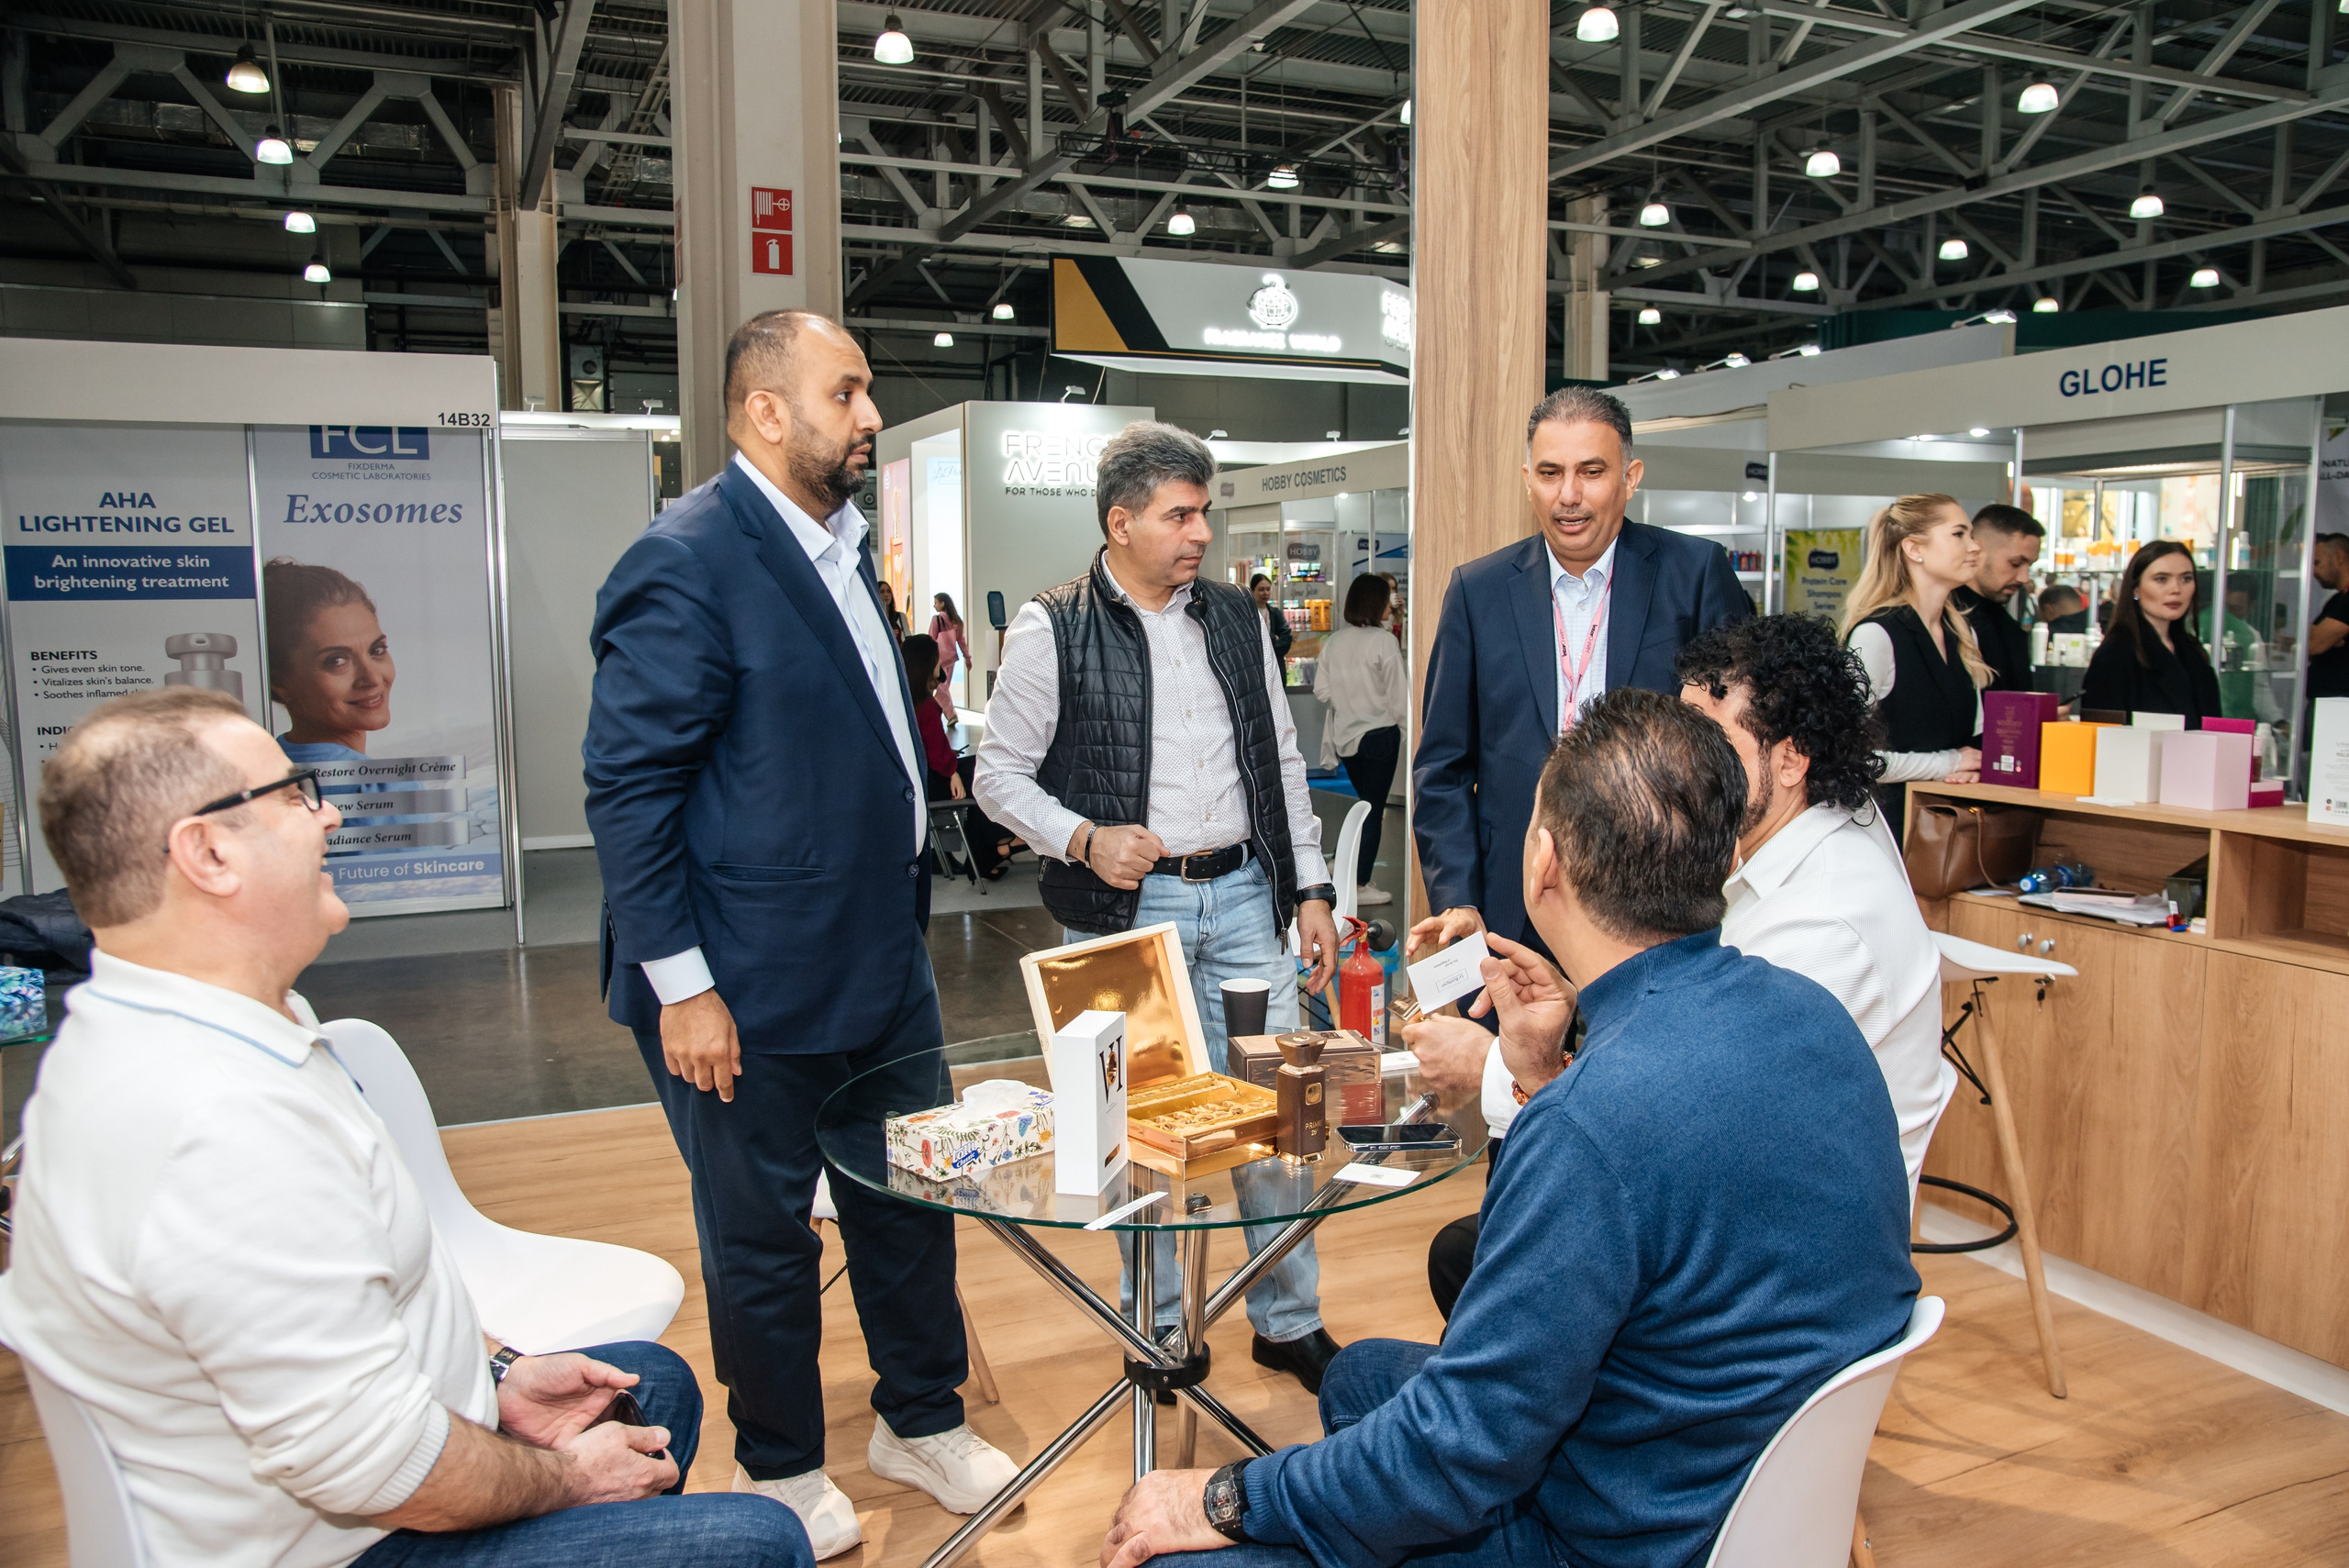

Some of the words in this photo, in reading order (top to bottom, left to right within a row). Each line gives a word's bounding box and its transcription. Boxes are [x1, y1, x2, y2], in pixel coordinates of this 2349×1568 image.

[2060, 358, 2168, 397] GLOHE
[438, 413, 491, 427] 14B32
[1007, 434, 1103, 457] FRENC
[348, 462, 395, 471] FIXDERMA
[312, 472, 361, 480] COSMETIC
[363, 473, 431, 481] LABORATORIES
[1262, 473, 1292, 492] HOBBY
[1294, 466, 1347, 488] COSMETICS
[1006, 487, 1026, 495] FOR
[1030, 487, 1062, 496] THOSE
[1066, 488, 1087, 496] WHO
[99, 492, 157, 508] AHA
[283, 494, 463, 524] Exosomes
[19, 516, 182, 533] LIGHTENING
[188, 517, 235, 533] GEL
[1289, 548, 1318, 556] HOBBY
[52, 554, 77, 568] An
[83, 554, 172, 568] innovative
[176, 554, 210, 568] skin
[34, 575, 137, 592] brightening
[141, 575, 229, 589] treatment
[30, 651, 98, 661] BENEFITS
[41, 665, 70, 674] Gives
[72, 666, 95, 674] even
[98, 664, 117, 673] skin
[120, 664, 146, 673] tone.
[41, 677, 83, 686] Vitalizes
[86, 676, 113, 685] skin's
[115, 675, 155, 684] balance.
[43, 690, 83, 699] Soothes
[86, 689, 128, 698] inflamed
[314, 766, 355, 778] Restore
[358, 763, 417, 777] Overnight
[419, 762, 457, 774] Crème
[356, 799, 395, 811] Serum
[327, 835, 372, 846] adiance
[374, 831, 412, 843] Serum
[339, 865, 390, 880] Future
[394, 863, 409, 876] of
[414, 860, 485, 874] Skincare
